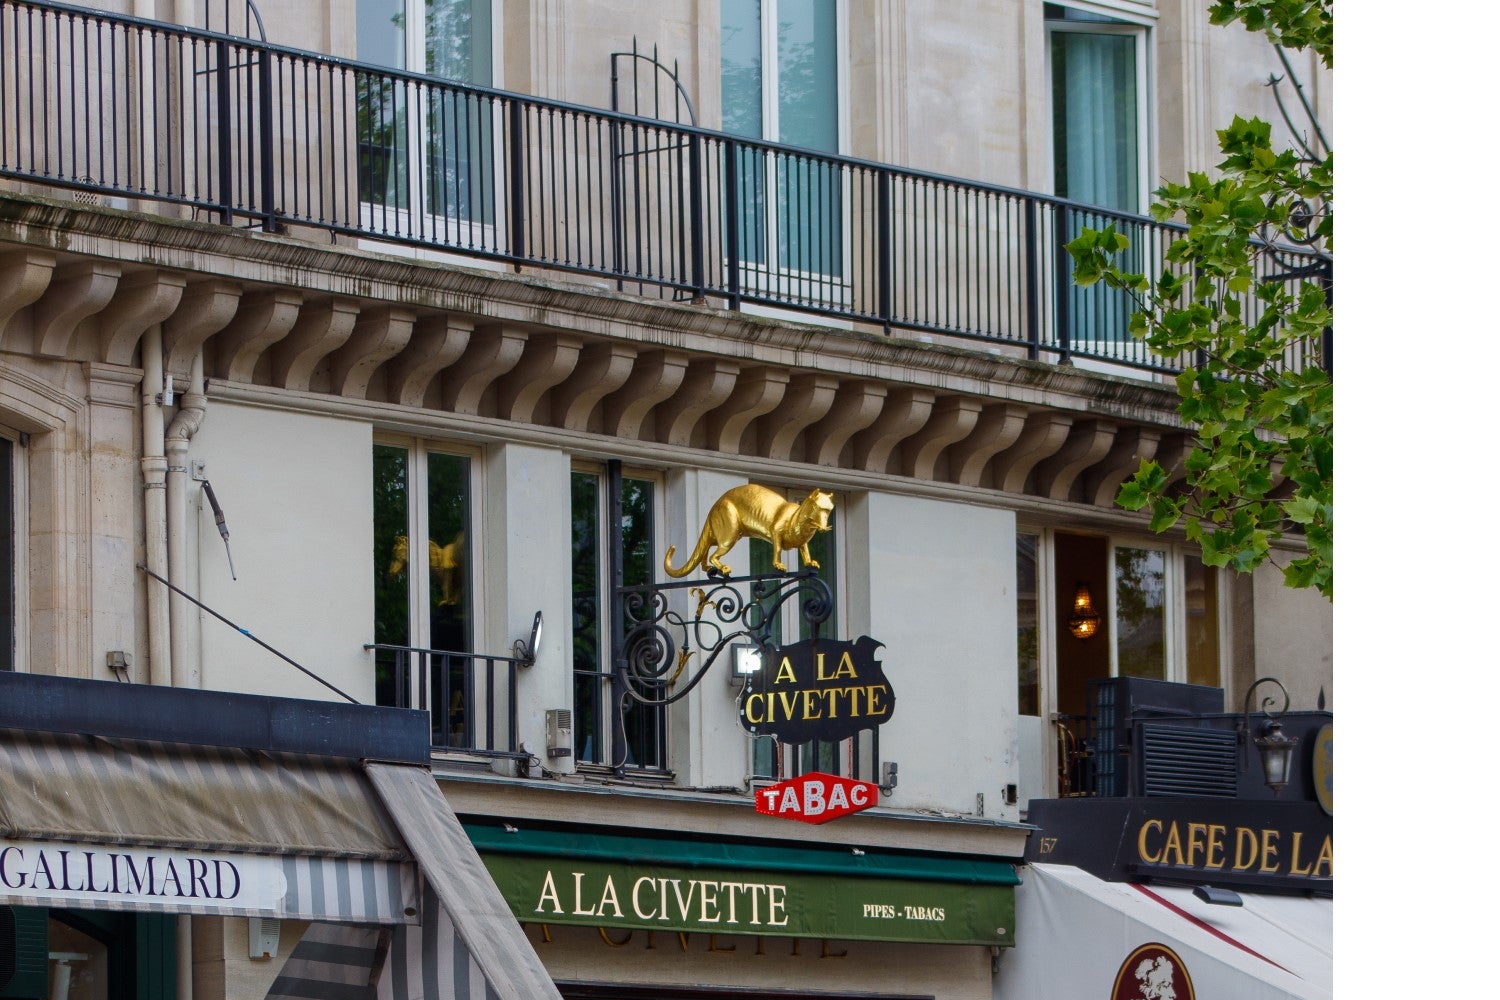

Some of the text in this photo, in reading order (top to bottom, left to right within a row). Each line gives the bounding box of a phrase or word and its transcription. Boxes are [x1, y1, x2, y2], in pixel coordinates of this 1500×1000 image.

[774, 651, 858, 684] A LA
[745, 685, 887, 724] CIVETTE
[763, 780, 868, 815] TABAC
[1039, 837, 1057, 853] 157
[1138, 820, 1228, 869] CAFE
[1233, 827, 1281, 872] DE
[0, 846, 241, 900] GALLIMARD
[534, 870, 789, 926] A LA CIVETTE
[863, 904, 895, 918] PIPES
[904, 906, 945, 921] TABACS
